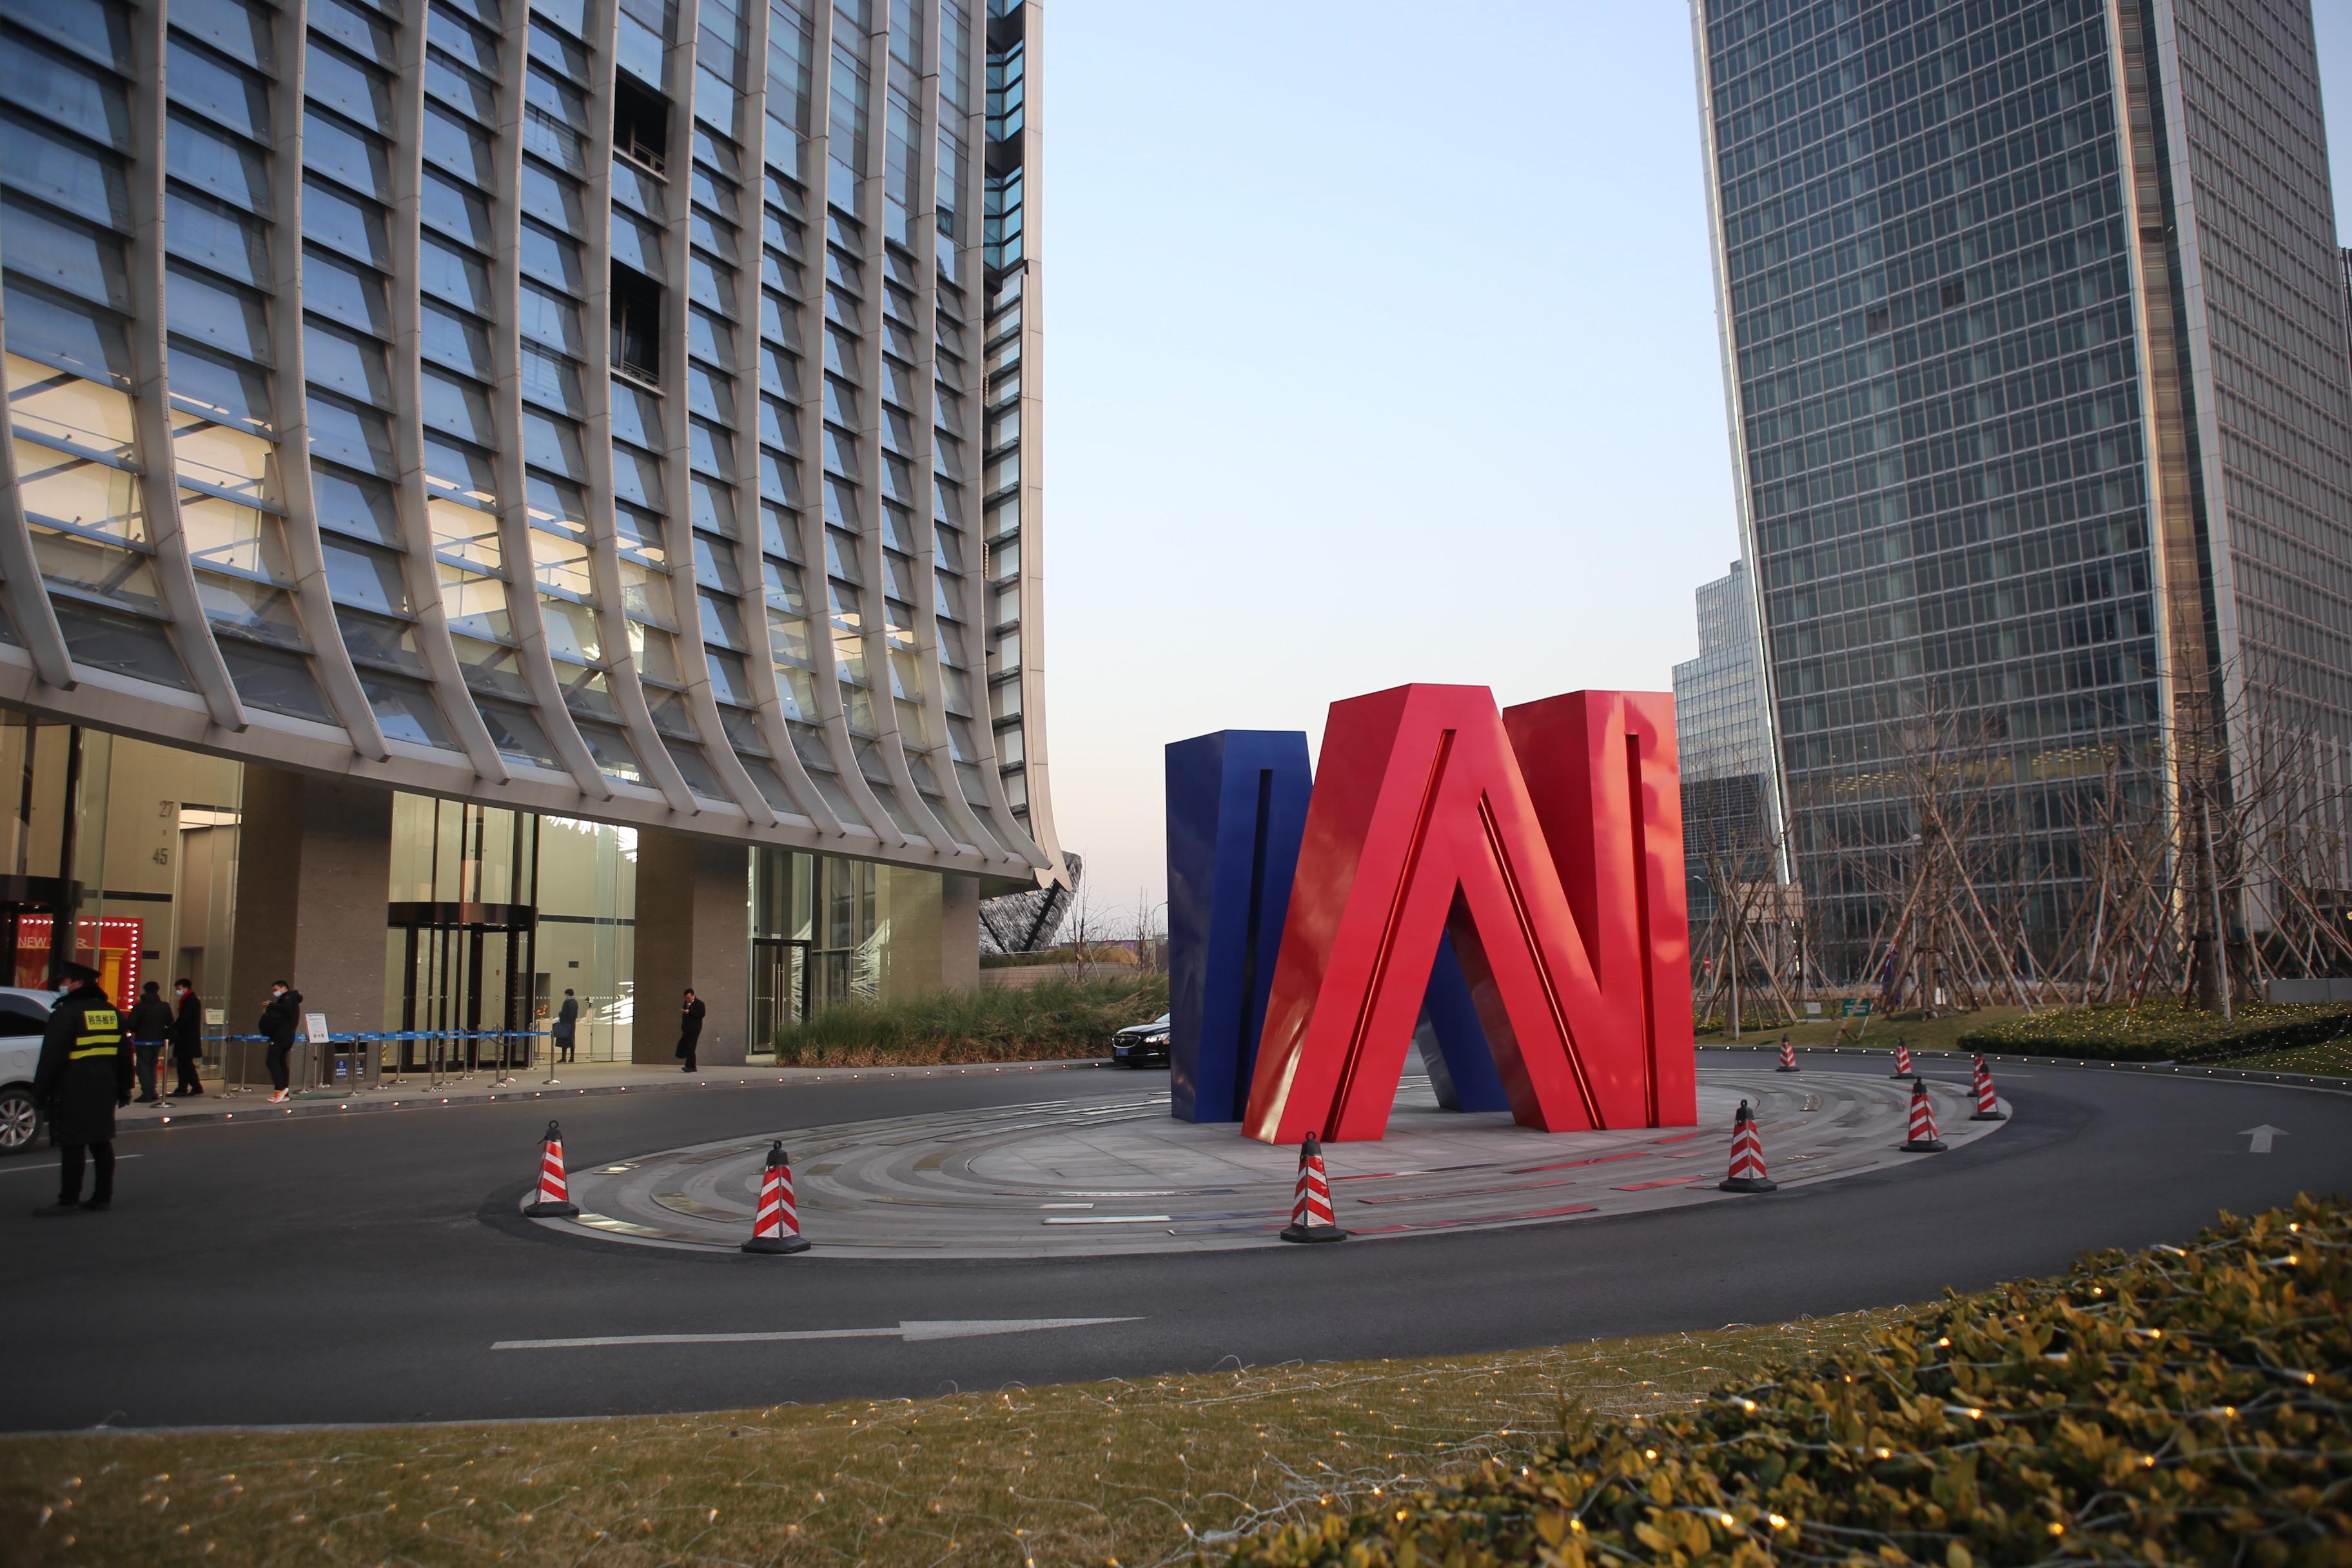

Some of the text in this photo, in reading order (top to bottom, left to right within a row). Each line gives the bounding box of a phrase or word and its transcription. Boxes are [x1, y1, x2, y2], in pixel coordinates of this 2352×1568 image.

[159, 801, 175, 818] 27
[152, 847, 168, 865] 45
[17, 937, 47, 947] NEW
[88, 1015, 116, 1024] 秩序维护
